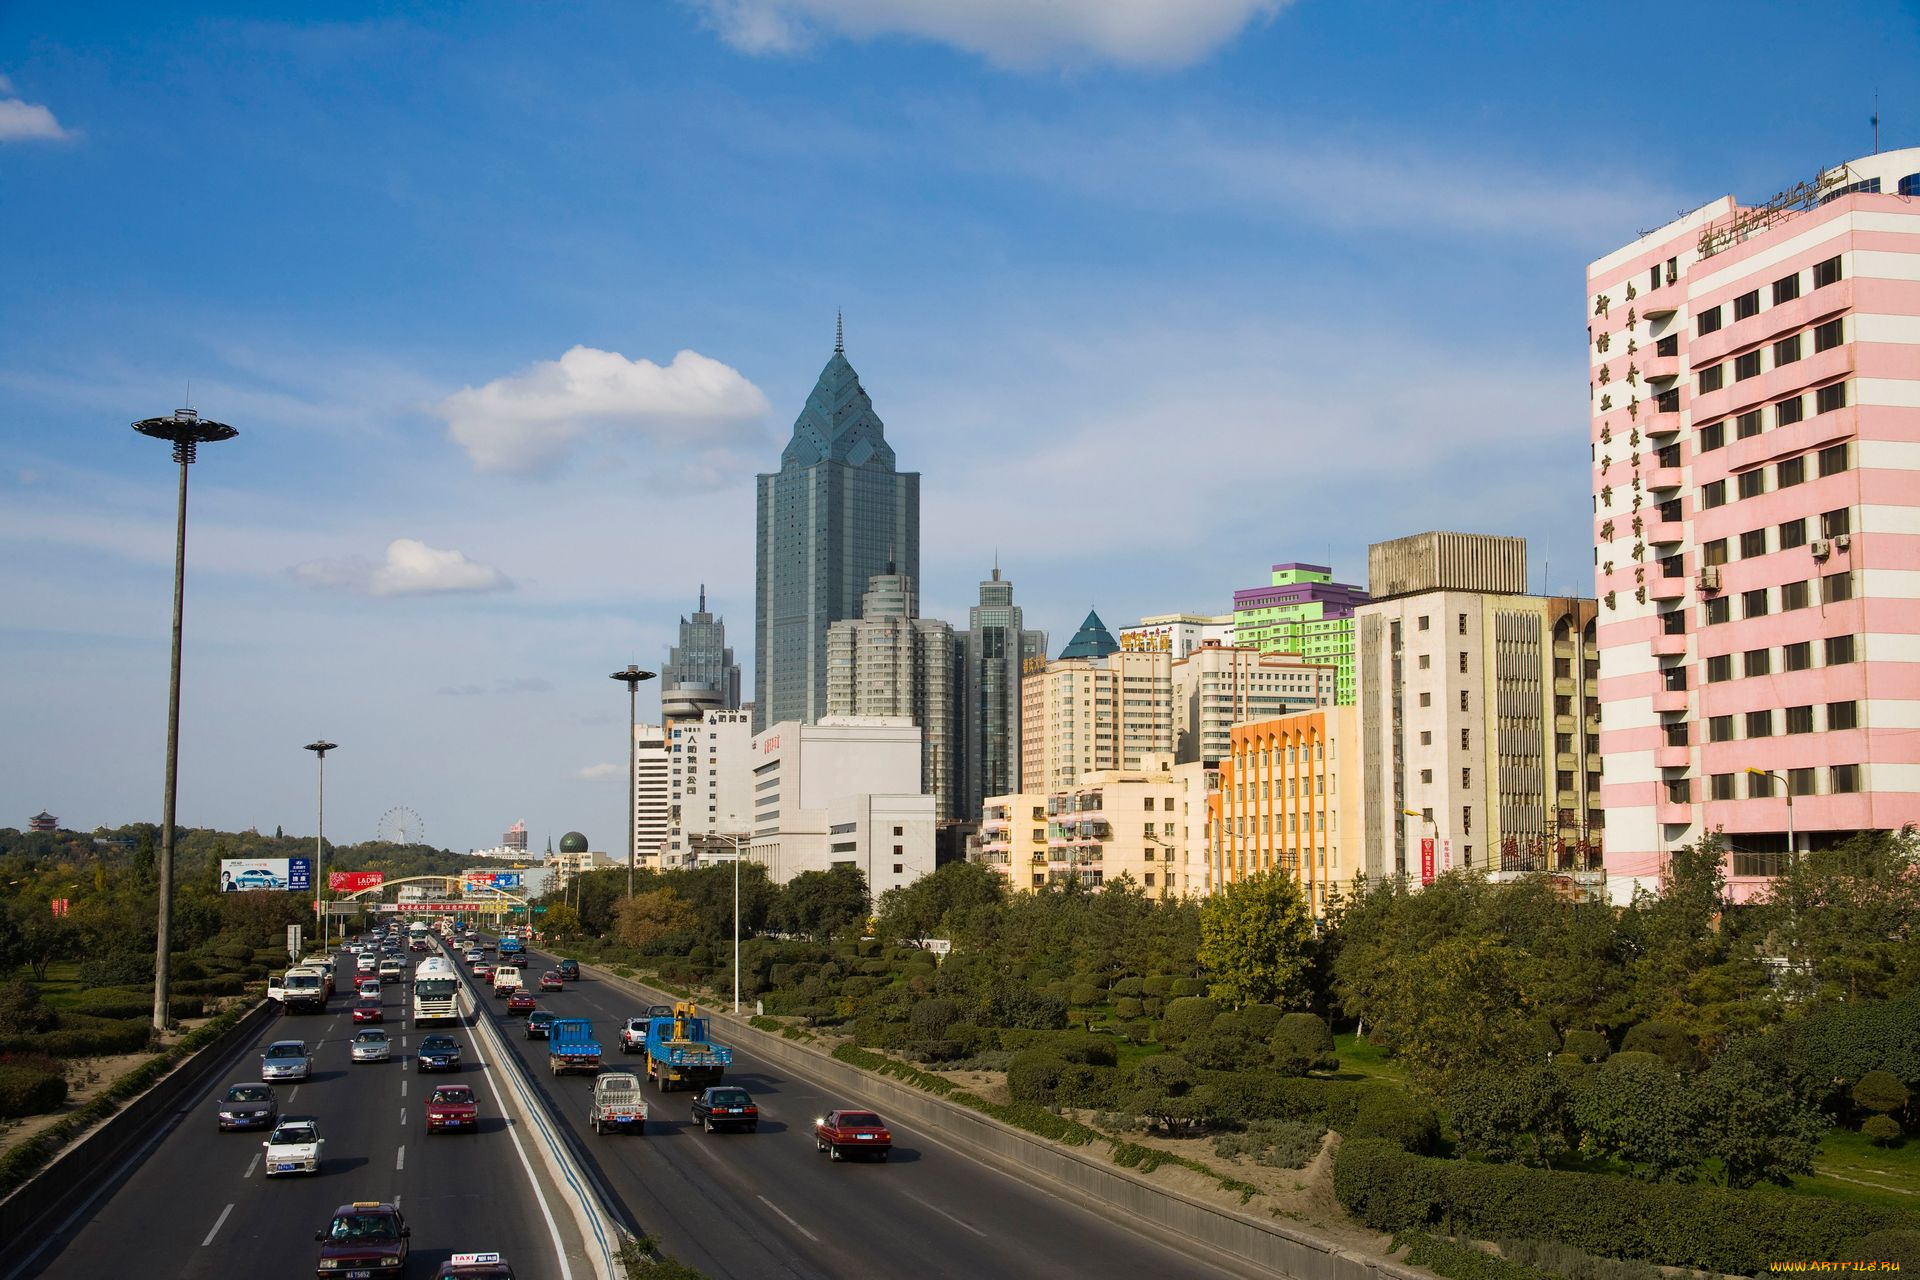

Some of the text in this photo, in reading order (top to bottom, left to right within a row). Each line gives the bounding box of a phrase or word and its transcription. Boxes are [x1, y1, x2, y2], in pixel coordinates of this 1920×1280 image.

[687, 735, 697, 795] 人防集团公司
